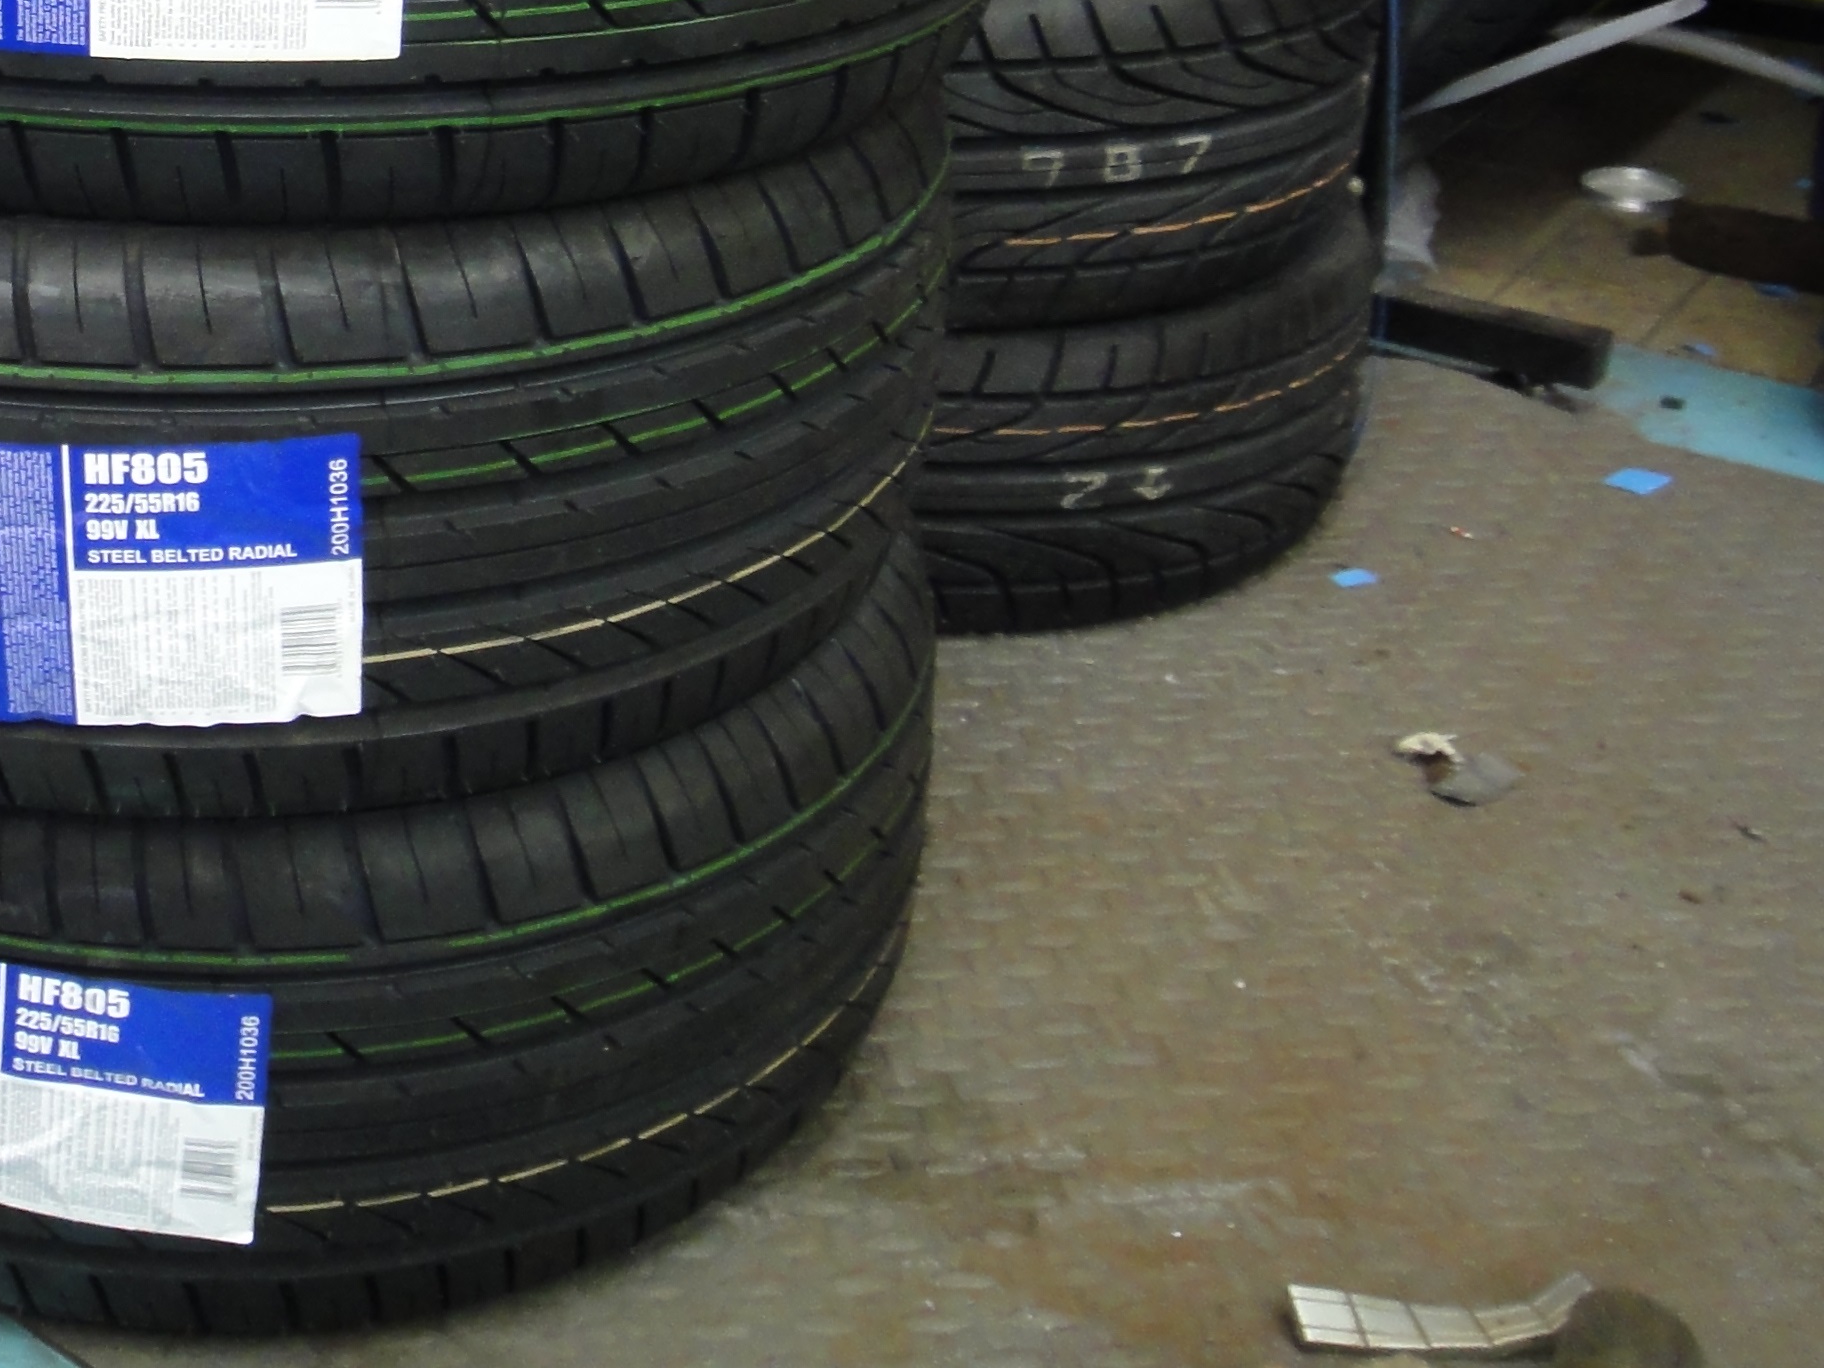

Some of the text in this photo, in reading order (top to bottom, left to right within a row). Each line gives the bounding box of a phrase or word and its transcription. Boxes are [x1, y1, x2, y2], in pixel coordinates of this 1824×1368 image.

[83, 451, 209, 485] HF805
[84, 491, 200, 514] 225/55R16
[328, 458, 351, 556] 200H1036
[85, 518, 160, 540] 99V XL
[87, 544, 298, 564] STEEL BELTED RADIAL
[18, 973, 131, 1018] HF805
[15, 1008, 120, 1044] 225/55R16
[14, 1031, 81, 1060] 99V XL
[235, 1014, 261, 1101] 200H1036
[12, 1057, 205, 1098] STEEL BELTED RADIAL
